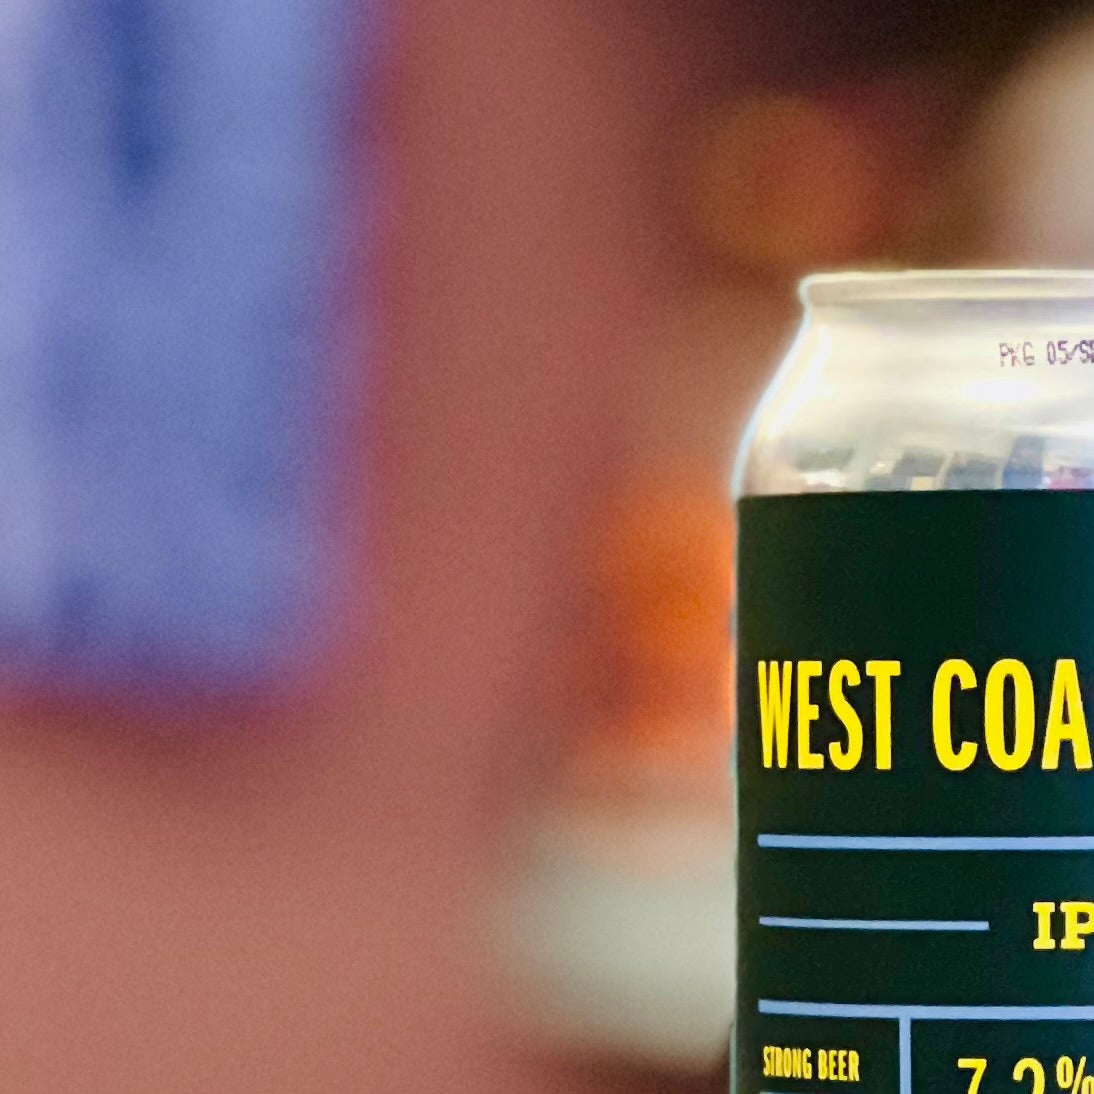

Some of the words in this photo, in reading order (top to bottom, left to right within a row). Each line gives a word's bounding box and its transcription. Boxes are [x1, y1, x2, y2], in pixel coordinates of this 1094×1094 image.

[999, 342, 1035, 367] PKG
[757, 659, 901, 771] WEST
[763, 1046, 812, 1080] STRONG
[817, 1048, 860, 1081] BEER
